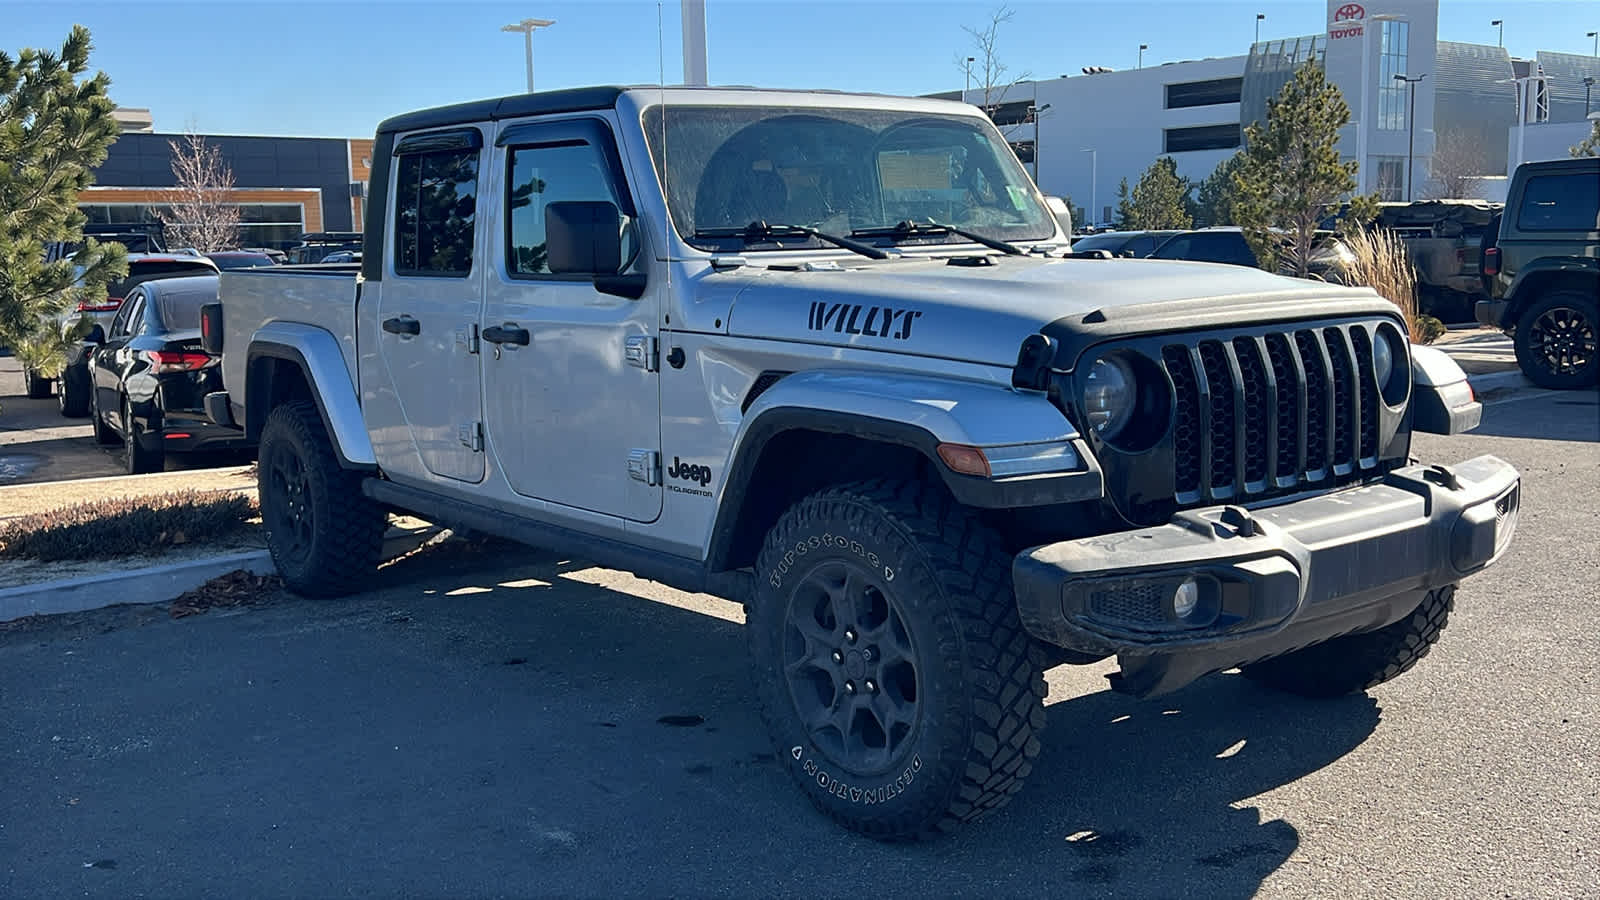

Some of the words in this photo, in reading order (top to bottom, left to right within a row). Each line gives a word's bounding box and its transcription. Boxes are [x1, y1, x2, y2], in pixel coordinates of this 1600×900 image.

[1329, 27, 1363, 40] TOYOT
[808, 301, 922, 340] WILLYS
[668, 456, 711, 487] Jeep
[673, 486, 713, 497] GLADIATOR
[770, 533, 879, 588] Firestone
[803, 753, 922, 804] DESTINATION
